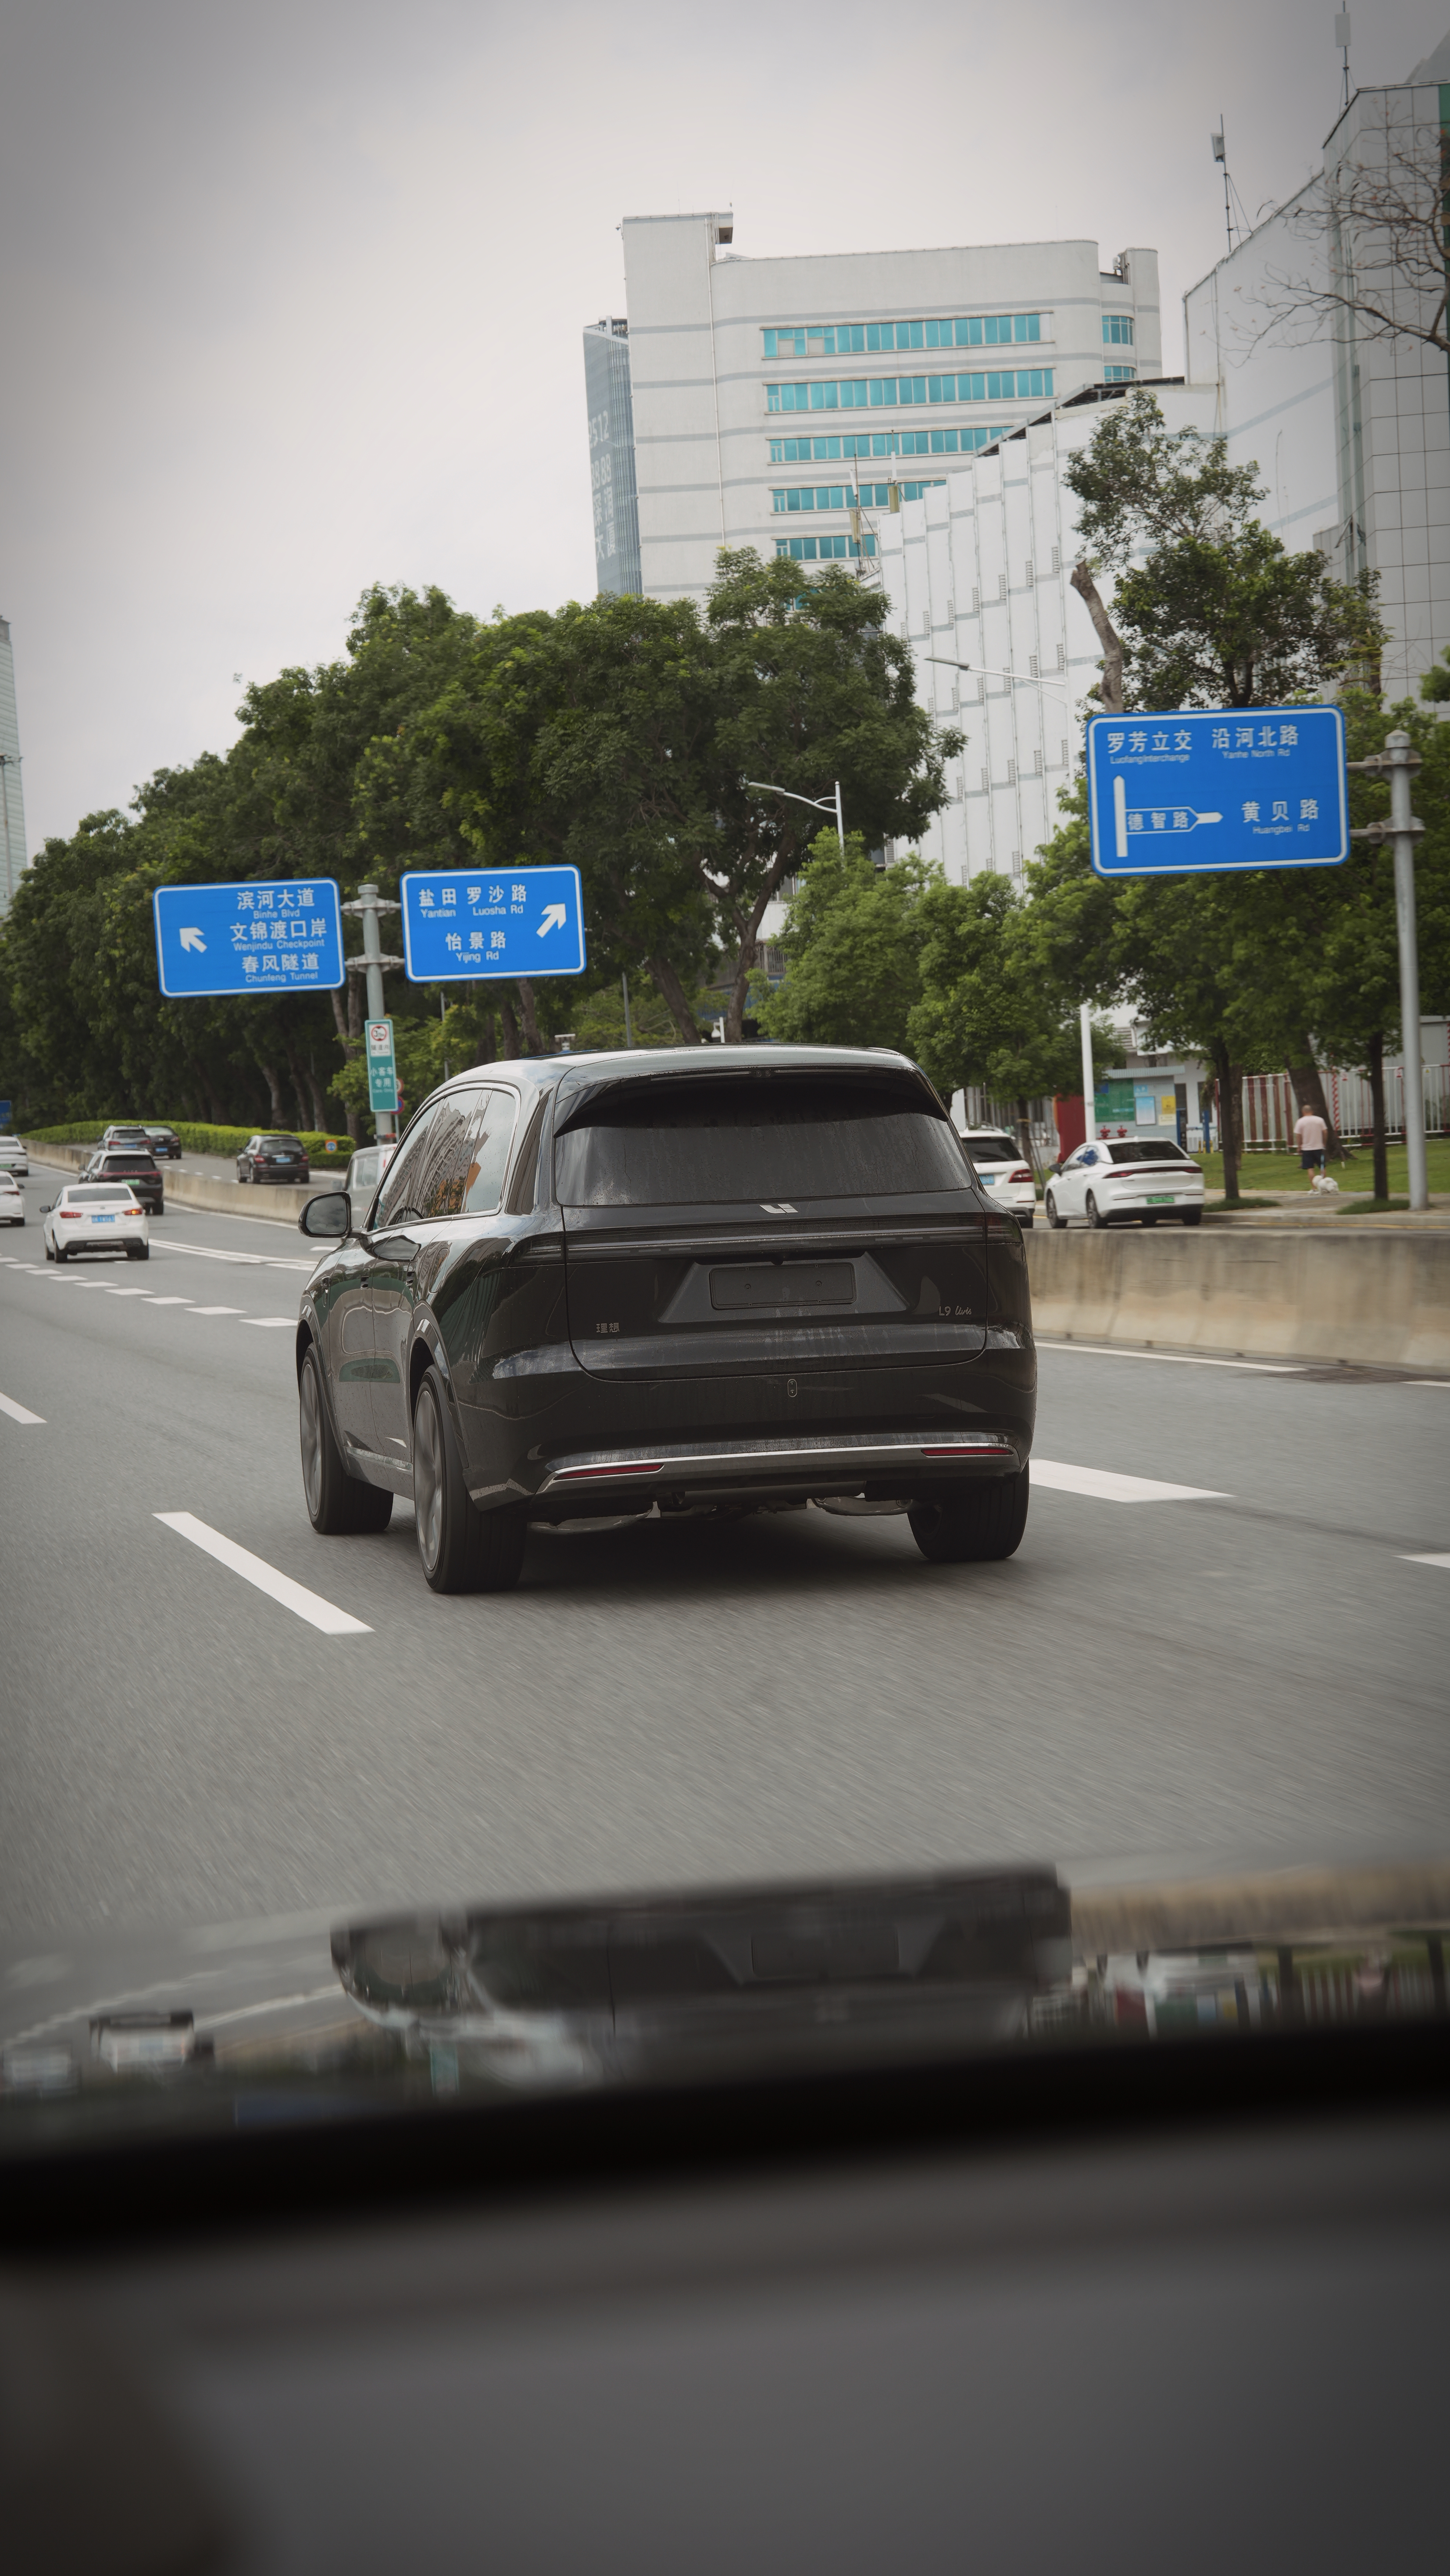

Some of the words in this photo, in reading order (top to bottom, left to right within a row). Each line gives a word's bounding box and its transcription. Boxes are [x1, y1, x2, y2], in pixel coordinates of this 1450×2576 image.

[1108, 730, 1192, 753] 罗芳立交
[1212, 725, 1298, 749] 沿河北路
[1242, 799, 1318, 822] 黄贝路
[1127, 811, 1189, 830] 德智路
[1253, 826, 1292, 835] Huangbei
[237, 887, 314, 910] 滨河大道
[419, 888, 456, 906] 盐田
[467, 884, 526, 904] 罗沙路
[253, 910, 278, 919] Binhe
[281, 909, 300, 917] Blvd
[421, 909, 456, 918] Yantian
[473, 906, 506, 916] Luosha
[511, 905, 523, 913] Rd
[230, 917, 326, 942] 文锦渡口岸
[233, 941, 273, 952] Wenjindu
[276, 938, 325, 949] Checkpoint
[446, 931, 506, 950] 怡景路
[242, 952, 319, 973] 春风隧道
[456, 952, 481, 963] Yijing
[486, 951, 499, 960] Rd
[246, 972, 286, 983] Chunfeng
[290, 972, 318, 980] Tunnel
[370, 1067, 393, 1077] 小客车
[939, 1306, 951, 1316] L9
[596, 1323, 620, 1333] 理想
